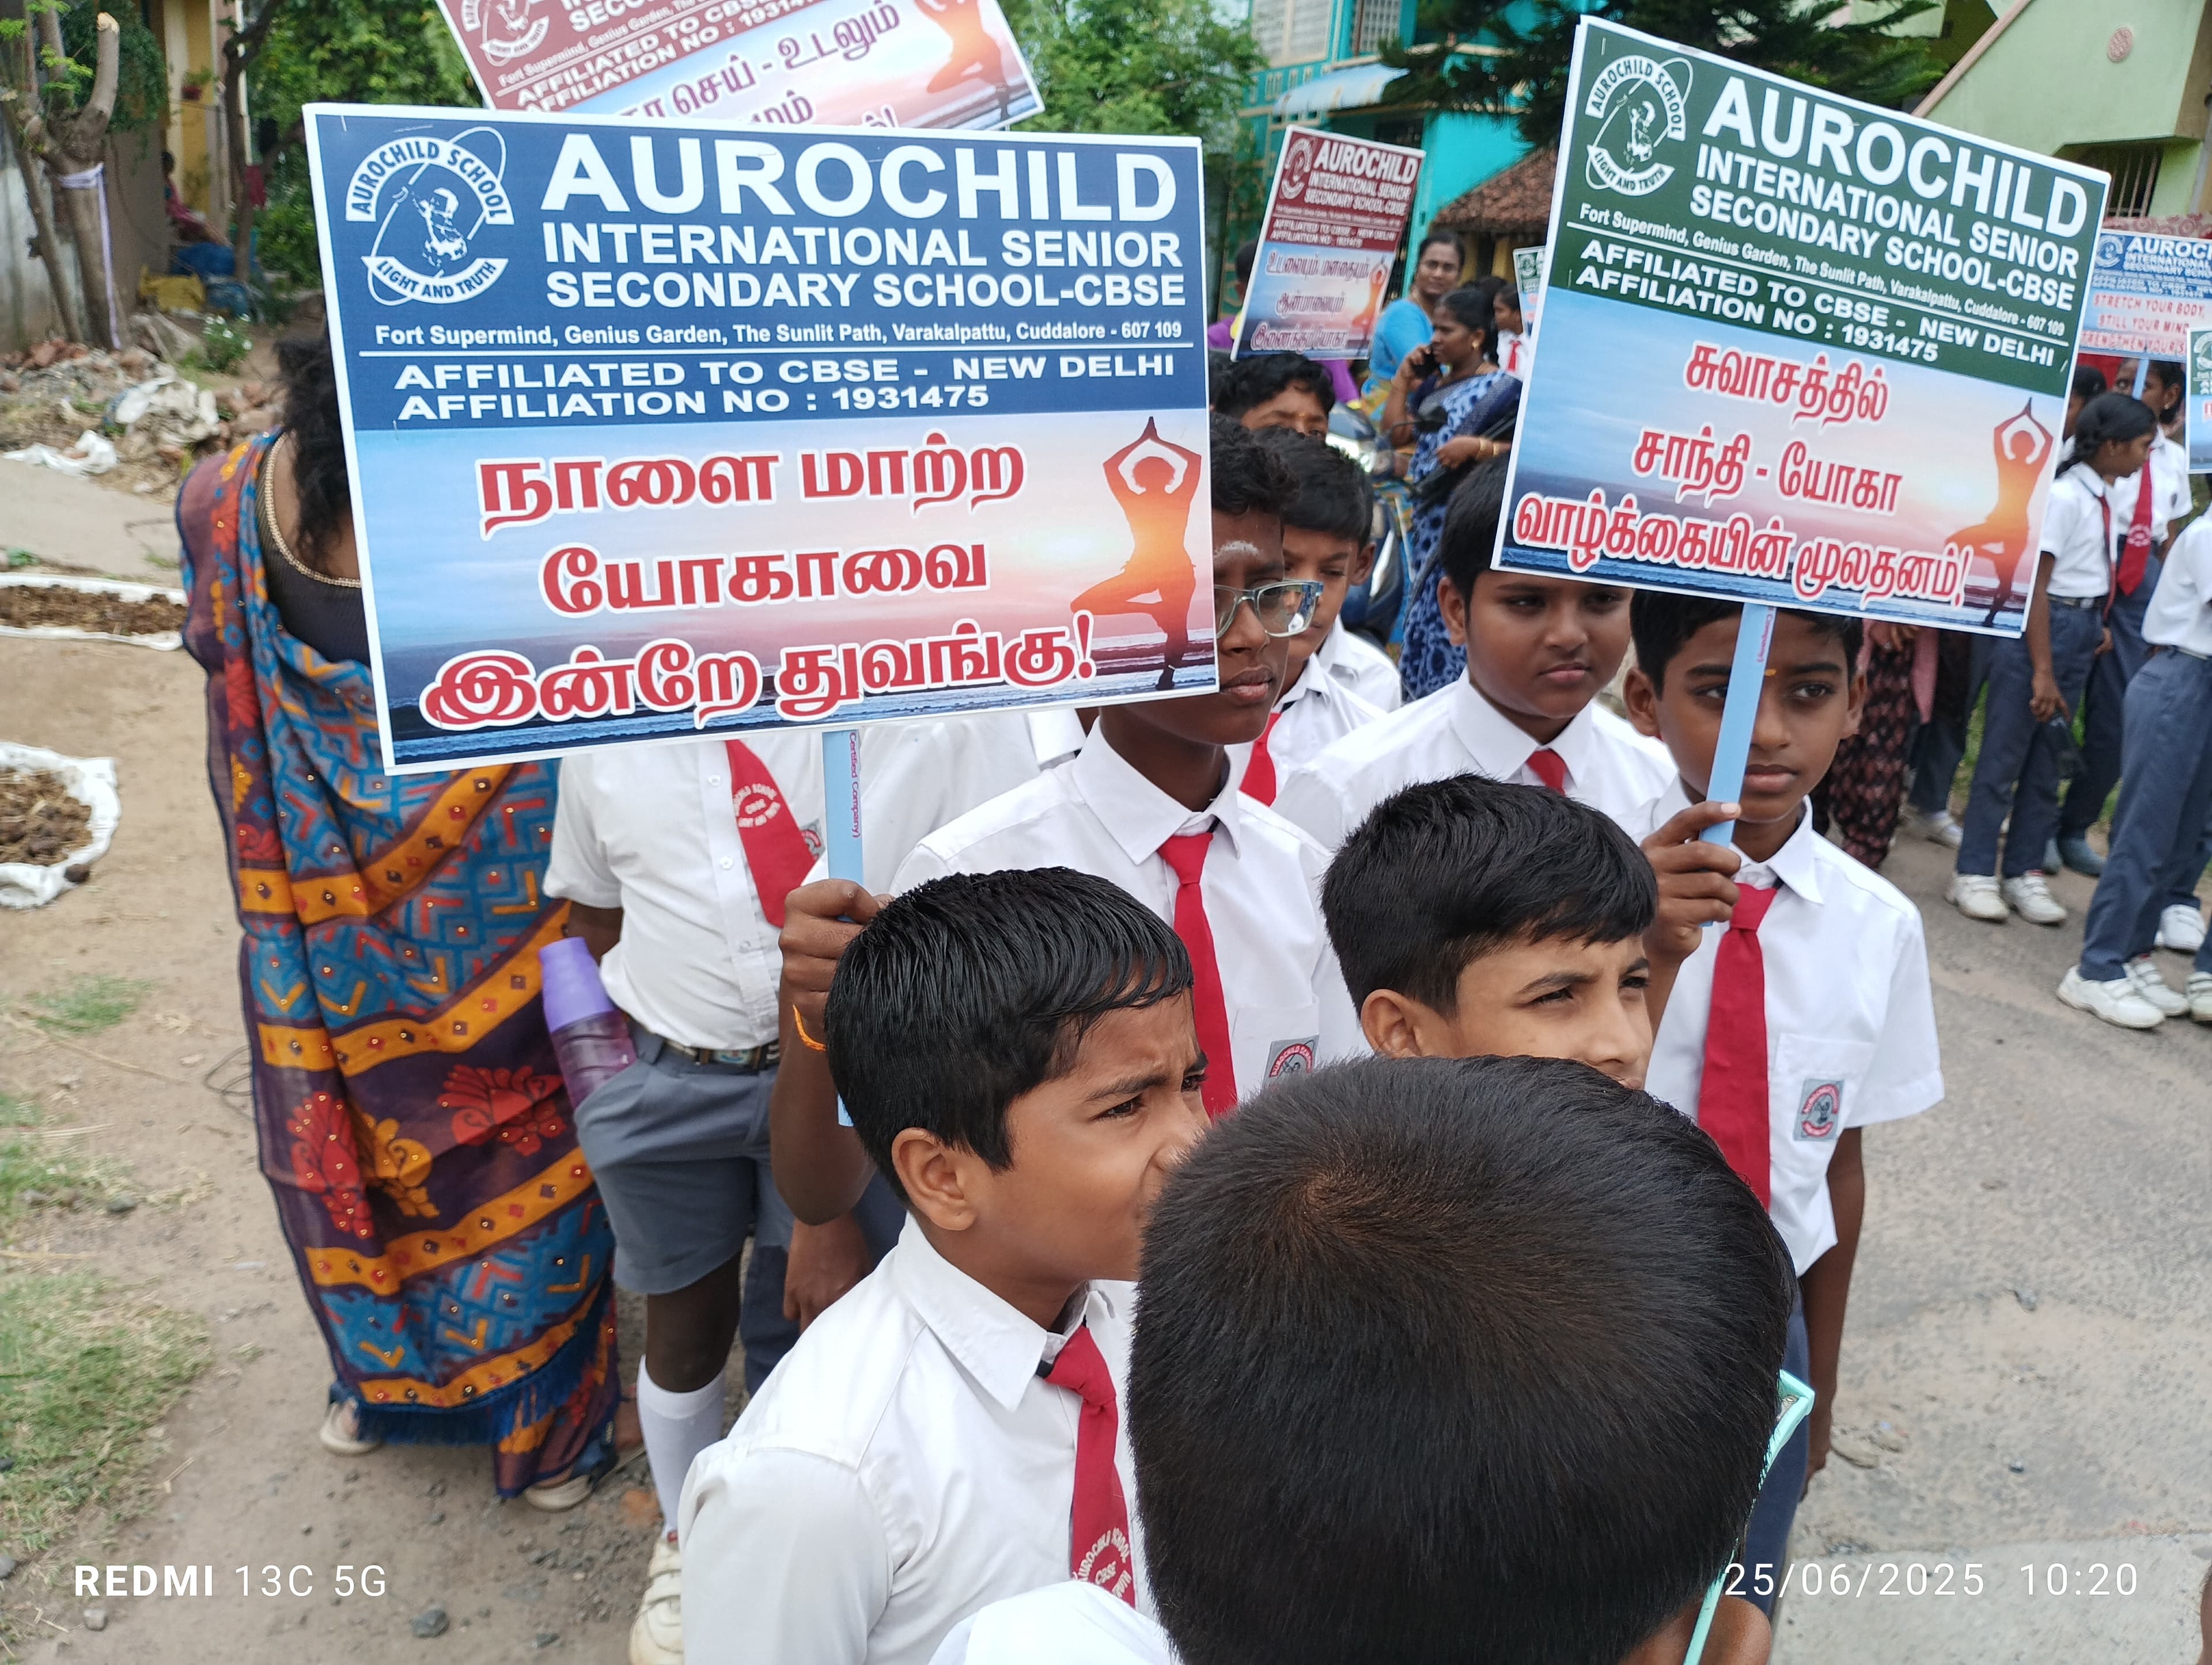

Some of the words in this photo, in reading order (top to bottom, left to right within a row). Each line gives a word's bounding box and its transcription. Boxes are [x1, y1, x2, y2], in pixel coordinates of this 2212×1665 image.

[517, 34, 660, 107] AFFILIATED
[662, 16, 700, 40] TO
[680, 26, 720, 52] NO
[1590, 59, 1653, 112] AUROCHILD
[1655, 68, 1683, 132] SCHOOL
[352, 141, 439, 215] AUROCHILD
[448, 149, 508, 219] SCHOOL
[540, 133, 1177, 222] AUROCHILD
[1313, 140, 1418, 184] AUROCHILD
[1702, 76, 2088, 238] AUROCHILD
[542, 222, 987, 266] INTERNATIONAL
[1001, 230, 1183, 267] SENIOR
[1690, 185, 1881, 259] SECONDARY
[1884, 238, 2075, 311] SCHOOL-CBSE
[1696, 144, 1960, 246] INTERNATIONAL
[1969, 222, 2080, 279] SENIOR
[377, 262, 418, 295] LIGHT
[421, 283, 453, 298] AND
[456, 262, 496, 293] TRUTH
[546, 271, 861, 308] SECONDARY
[873, 273, 1185, 308] SCHOOL-CBSE
[1580, 203, 1610, 226] Fort
[1612, 209, 1689, 248] Supermind,
[1692, 231, 1740, 257] Genius
[1741, 242, 1791, 271] Garden,
[1794, 255, 1818, 274] The
[1819, 261, 1856, 285] Sunlit
[1857, 270, 1887, 294] Path,
[1890, 279, 1961, 313] Varakalpattu,
[1964, 299, 2019, 324] Cuddalore
[375, 325, 424, 345] Fort
[430, 324, 558, 348] Supermind,
[564, 324, 639, 344] Genius
[646, 324, 728, 346] Garden,
[732, 324, 770, 343] The
[776, 324, 834, 342] Sunlit
[839, 324, 887, 344] Path,
[892, 323, 1011, 344] Varakalpattu,
[1016, 322, 1105, 340] Cuddalore
[1122, 321, 1150, 339] 607
[1154, 321, 1181, 339] 109
[1575, 265, 1765, 325] AFFILIATION
[1772, 310, 1817, 335] NO
[1824, 323, 1833, 339] :
[1841, 323, 1939, 363] 1931475
[1580, 239, 1759, 297] AFFILIATED
[1767, 280, 1806, 307] TO
[1814, 293, 1890, 327] CBSE
[1919, 317, 1979, 348] NEW
[1983, 333, 2055, 367] DELHI
[2146, 299, 2173, 313] YOUR
[394, 362, 684, 390] AFFILIATED
[699, 361, 763, 385] TO
[778, 358, 900, 384] CBSE
[953, 357, 1047, 381] NEW
[1060, 354, 1173, 378] DELHI
[397, 392, 706, 421] AFFILIATION
[723, 389, 789, 414] NO
[807, 394, 816, 410] :
[832, 385, 989, 410] 1931475
[1686, 345, 1888, 423] சுவாசத்தில்
[479, 455, 780, 537] நாளை
[801, 433, 1024, 514] மாற்ற
[1635, 426, 1749, 505] சாந்தி
[1756, 468, 1769, 477] -
[1779, 441, 1903, 514] யோகா
[542, 544, 987, 614] யோகாவை
[1516, 488, 1793, 575] வாழ்க்கையின்
[1797, 536, 1971, 606] மூலதனம்!
[425, 643, 758, 725] இன்றே
[779, 614, 1093, 716] துவங்கு!
